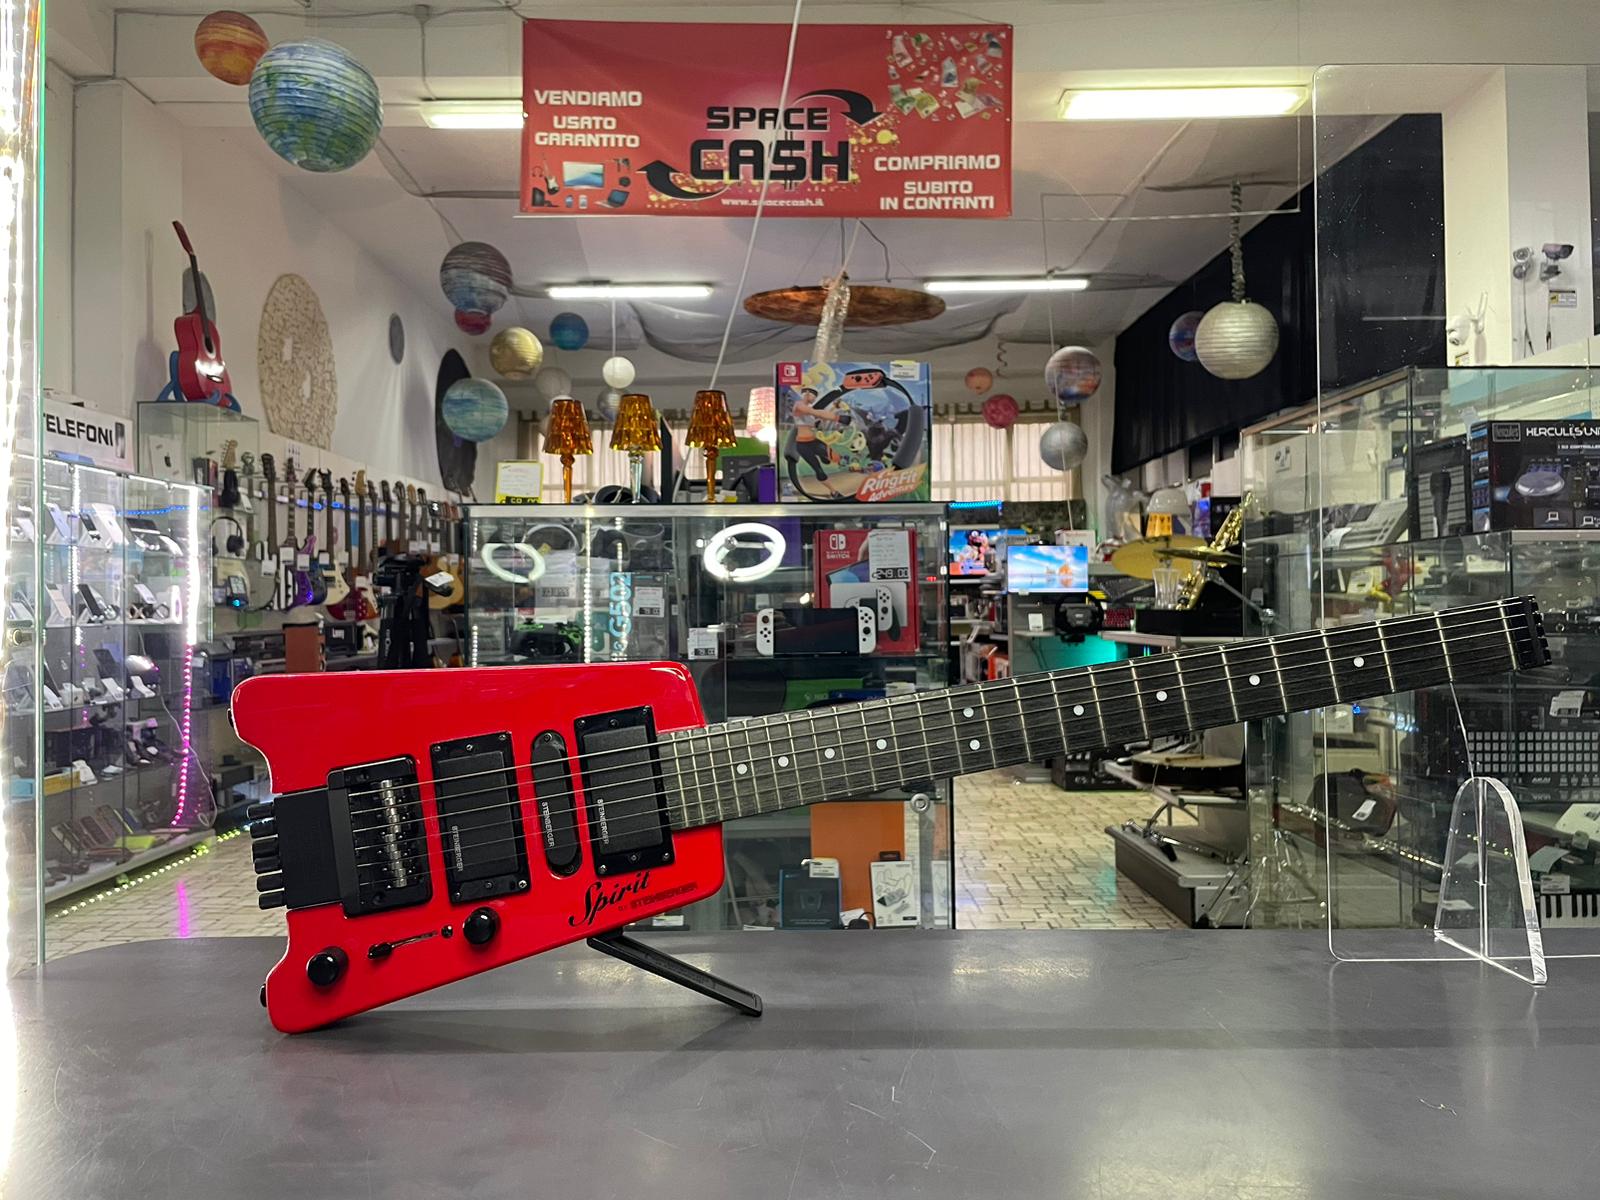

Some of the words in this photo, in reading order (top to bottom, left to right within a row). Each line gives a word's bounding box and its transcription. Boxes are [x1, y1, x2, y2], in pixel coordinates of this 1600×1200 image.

[534, 89, 643, 107] VENDIAMO
[553, 115, 617, 130] USATO
[706, 106, 828, 130] SPACE
[535, 131, 641, 148] GARANTITO
[874, 154, 1000, 171] COMPRIAMO
[904, 180, 973, 194] SUBITO
[721, 198, 824, 206] www.sacecash.it
[880, 197, 898, 210] IN
[903, 195, 994, 210] CONTANTI
[43, 412, 113, 446] ELEFONI
[568, 870, 650, 928] Spirit
